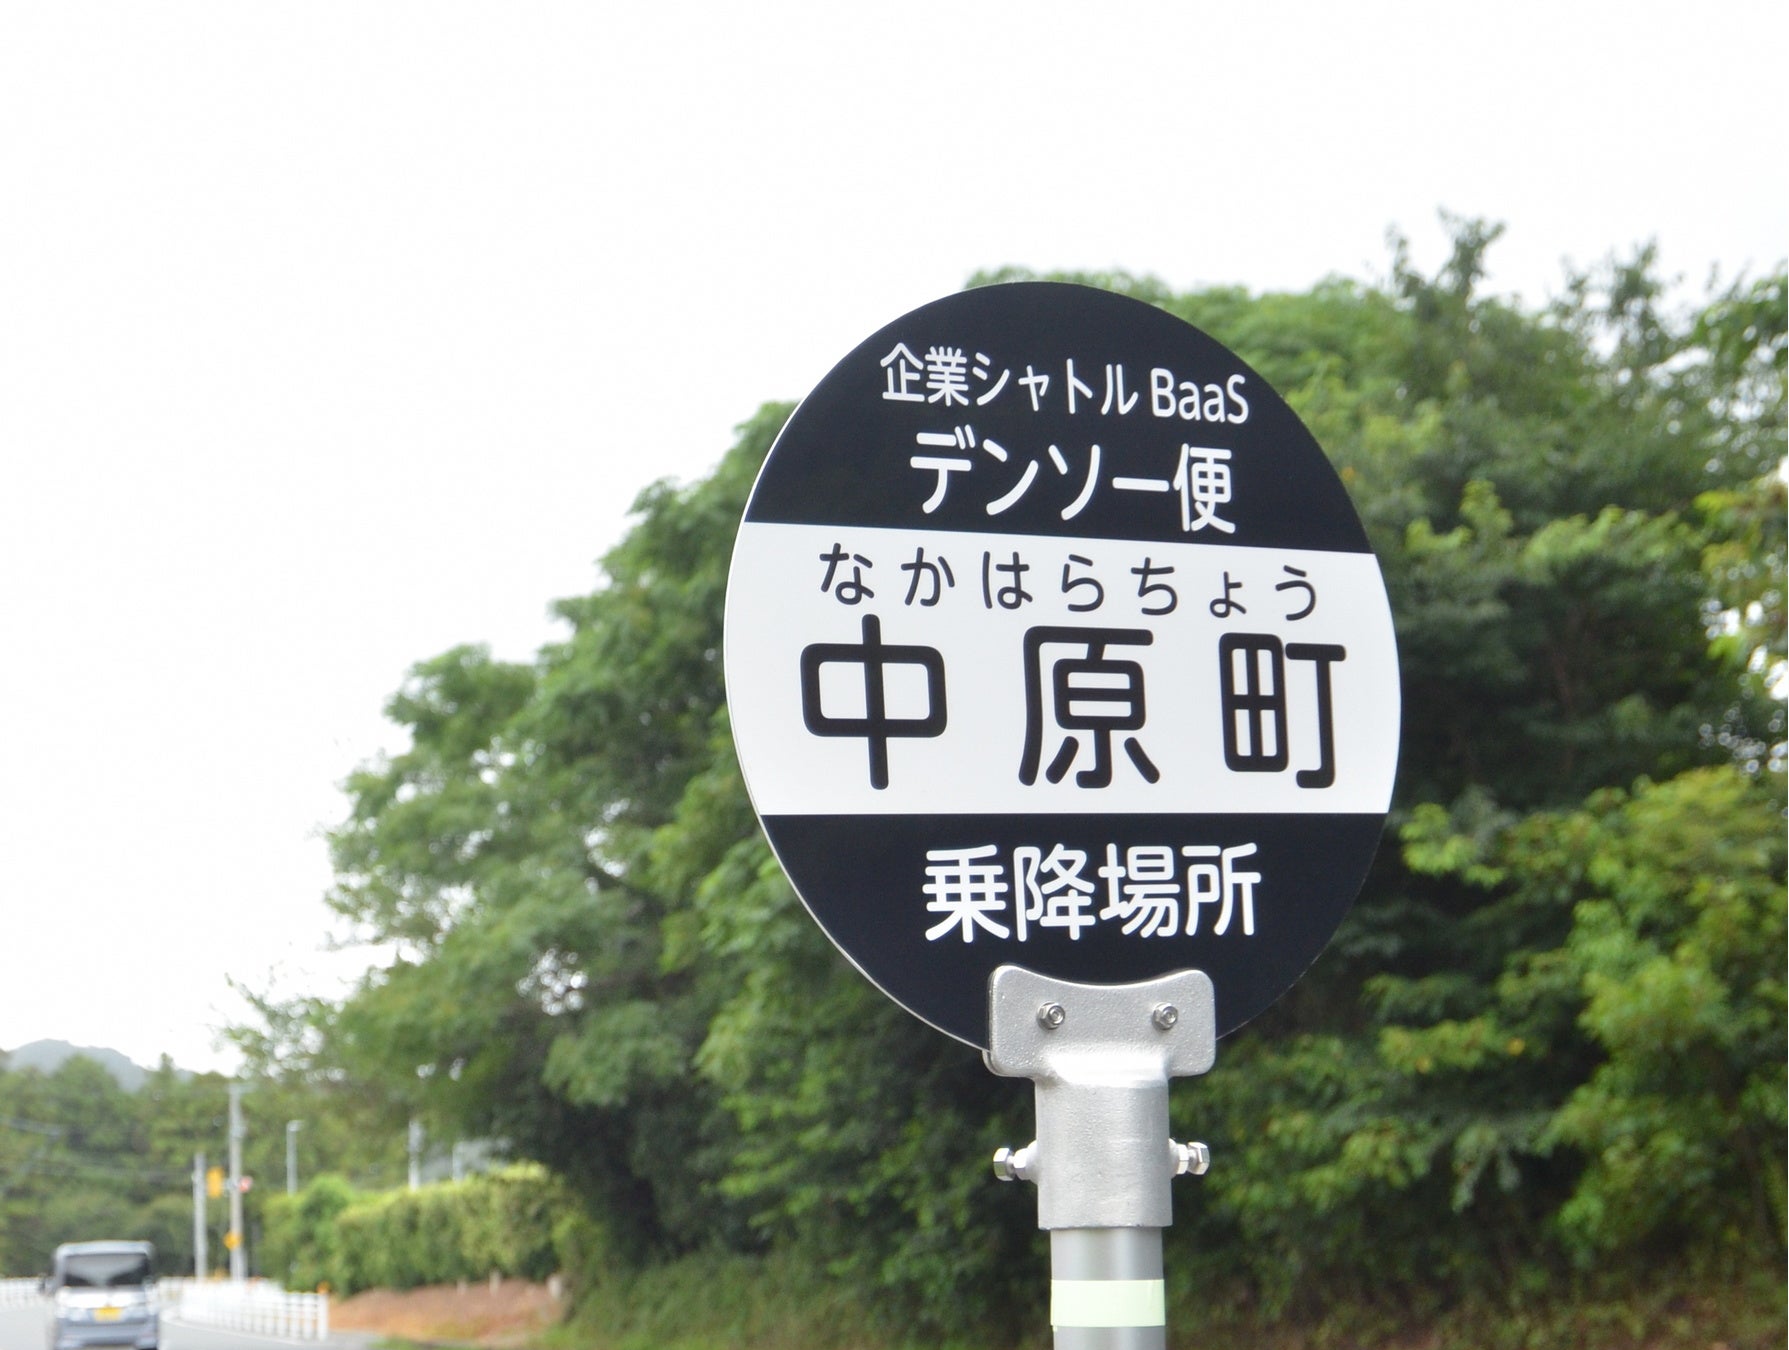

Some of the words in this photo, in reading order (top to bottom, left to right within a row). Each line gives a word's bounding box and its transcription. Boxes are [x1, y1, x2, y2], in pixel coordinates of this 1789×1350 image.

[880, 342, 1138, 415] 企業シャトル
[1150, 367, 1249, 425] BaaS
[910, 424, 1236, 534] デンソー便
[819, 542, 1318, 622] なかはらちょう
[800, 613, 1347, 790] 中原町
[922, 842, 1262, 943] 乗降場所
